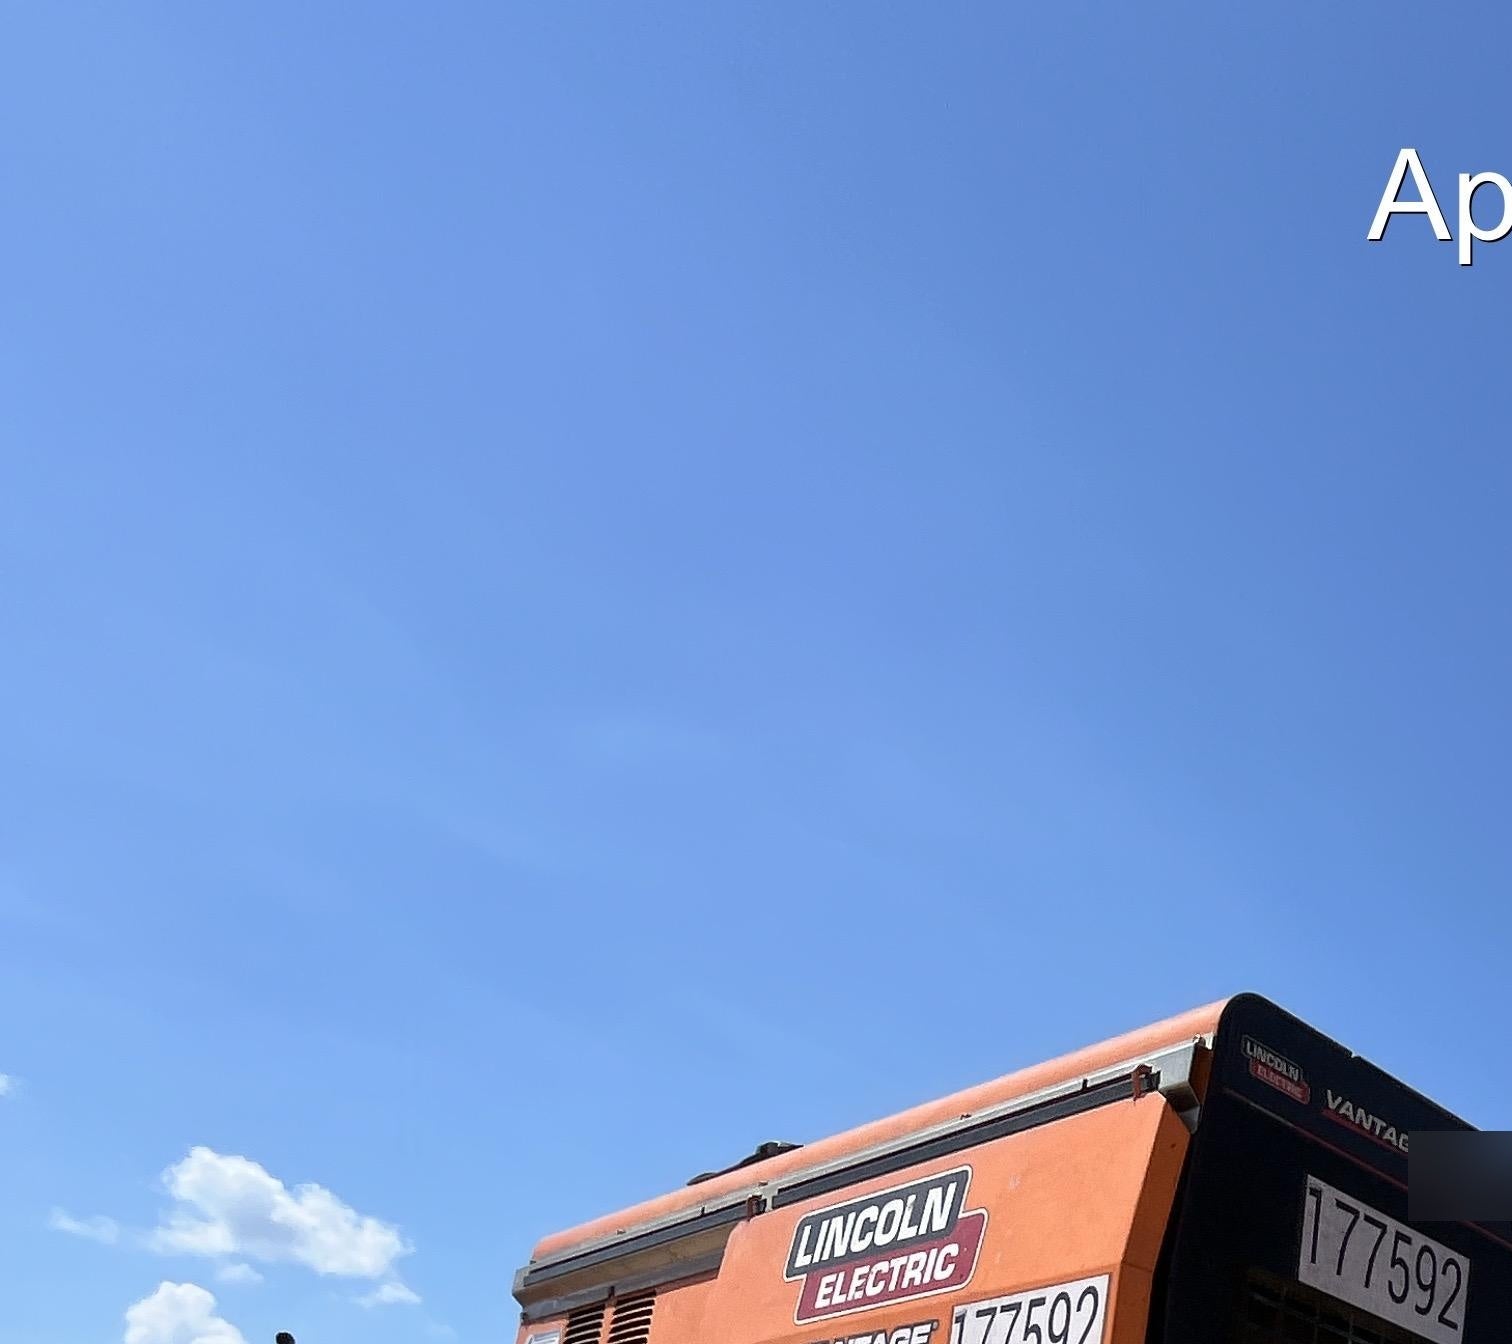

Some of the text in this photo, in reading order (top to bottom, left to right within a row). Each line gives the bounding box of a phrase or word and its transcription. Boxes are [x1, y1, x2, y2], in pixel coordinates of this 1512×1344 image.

[1246, 1040, 1300, 1081] LINCOLN
[1326, 1089, 1409, 1153] VANTAG
[795, 1182, 958, 1268] LINCOLN
[1309, 1186, 1463, 1331] 177592
[814, 1243, 959, 1310] ELECTRIC
